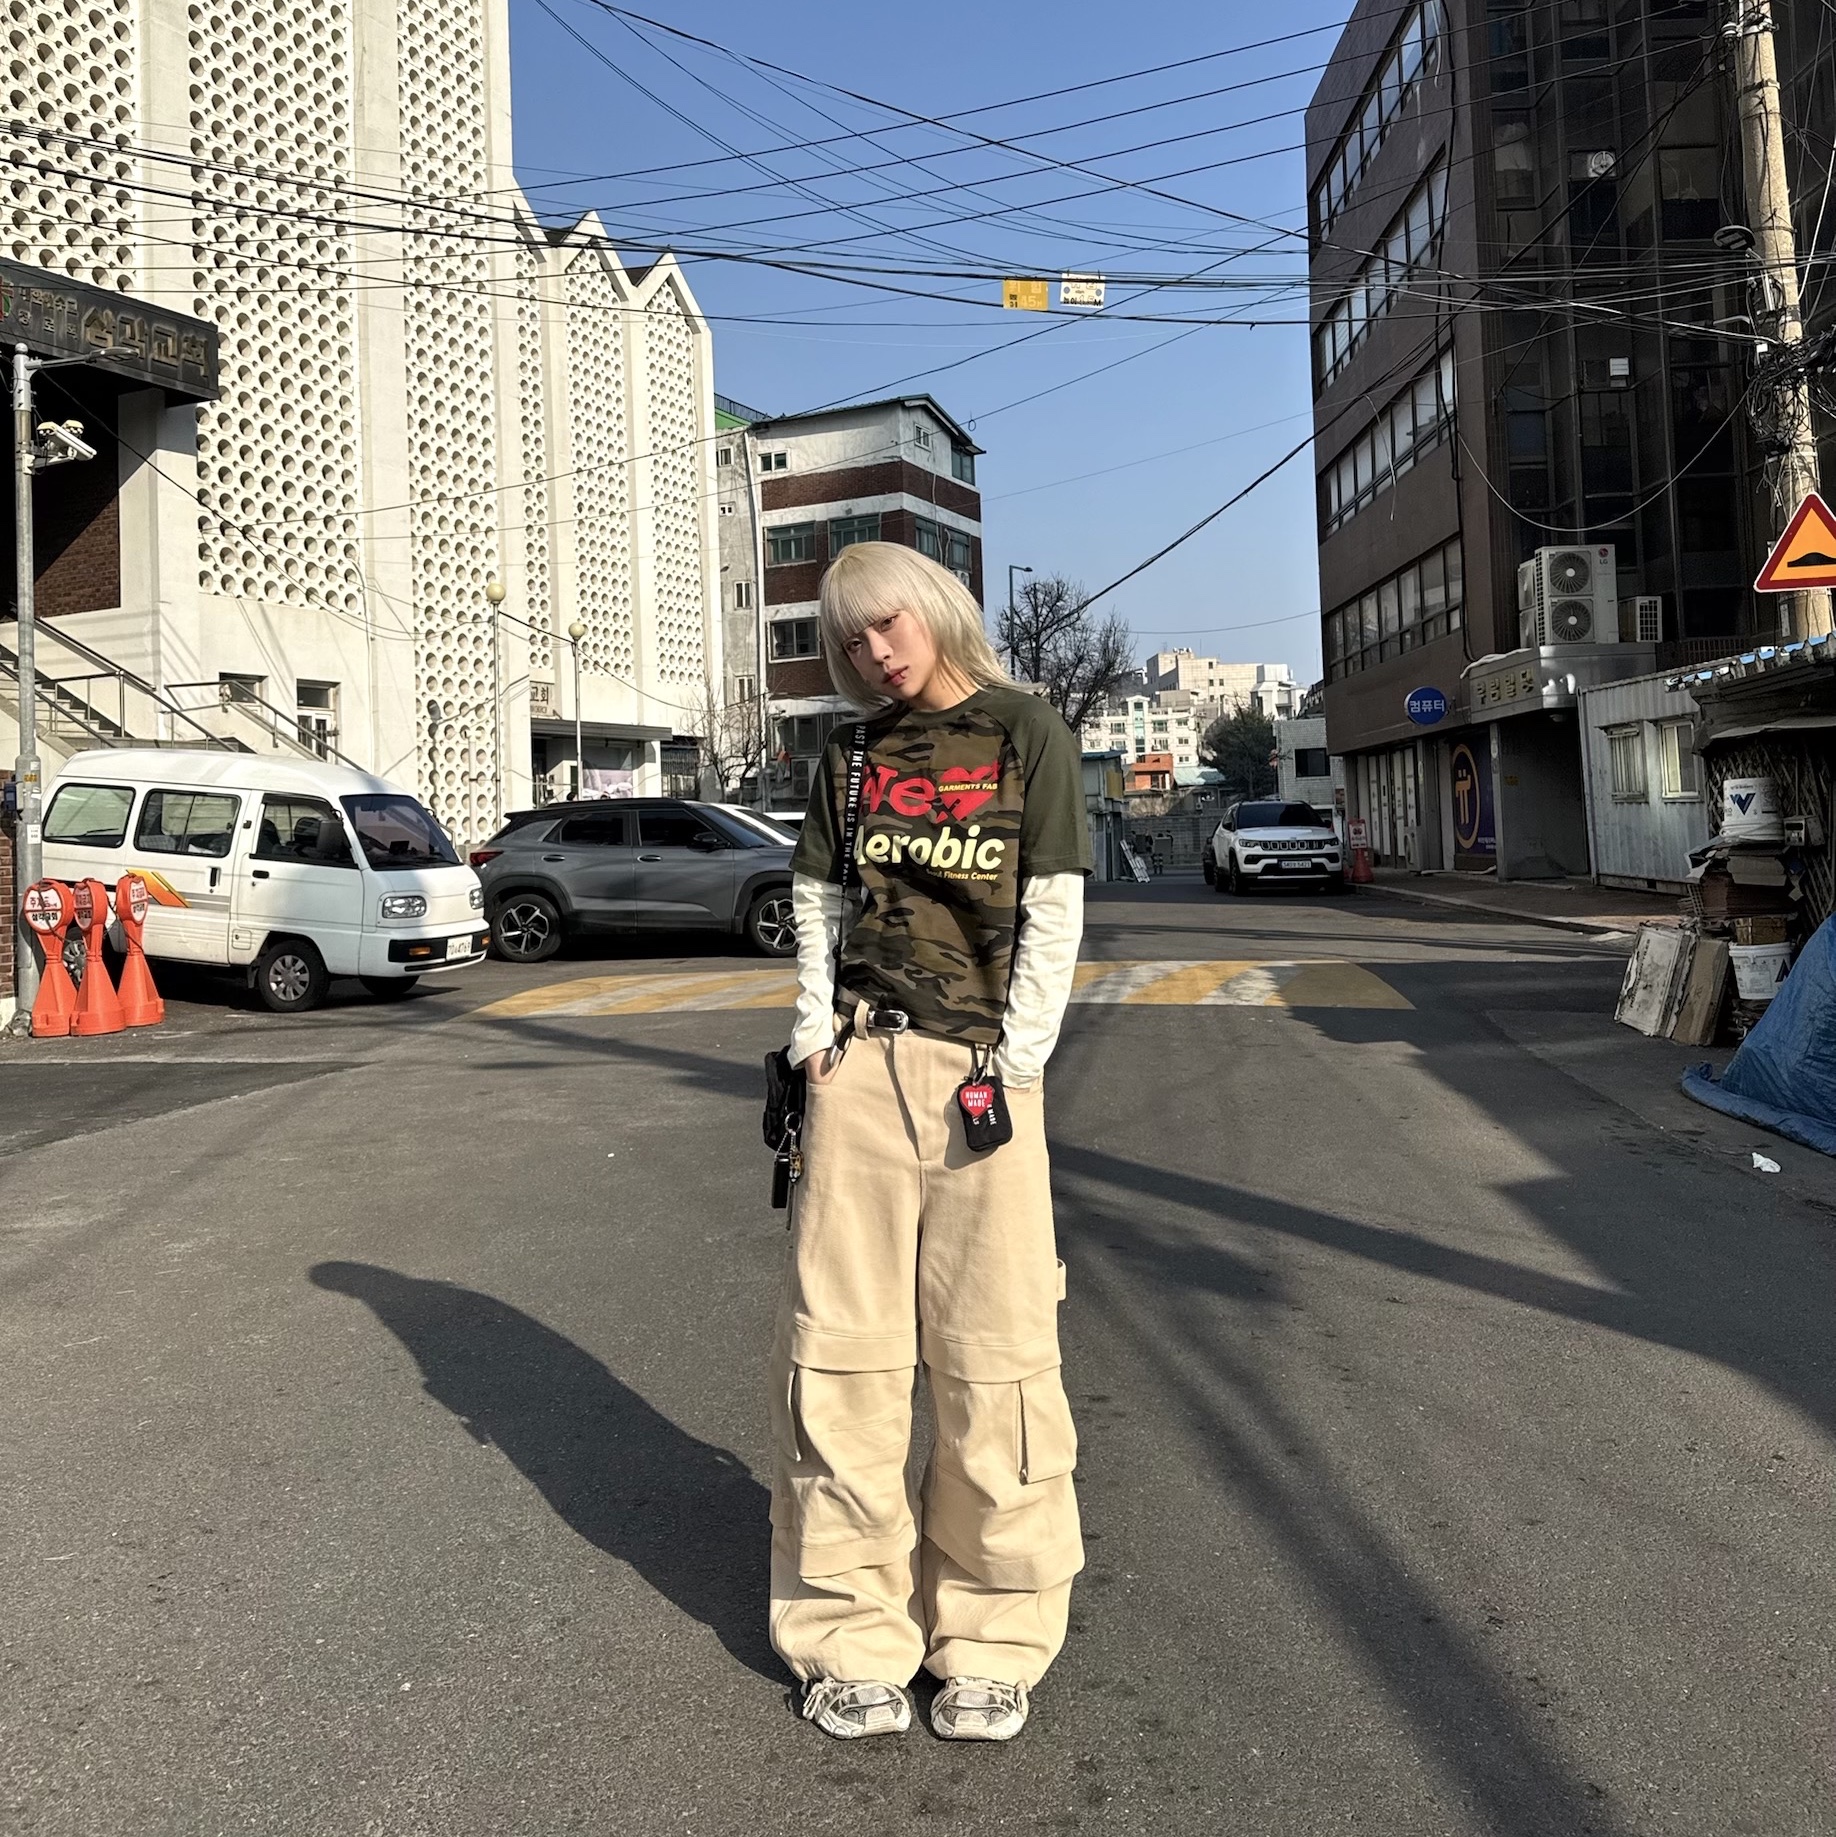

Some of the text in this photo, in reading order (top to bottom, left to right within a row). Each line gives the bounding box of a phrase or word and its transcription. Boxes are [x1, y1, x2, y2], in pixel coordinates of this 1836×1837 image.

[1409, 699, 1445, 713] 컴퓨터
[852, 750, 864, 768] THE
[848, 771, 861, 808] FUTURE
[938, 783, 980, 793] GARMENTS
[846, 813, 856, 823] IS
[845, 827, 854, 838] IN
[844, 841, 853, 858] THE
[944, 870, 969, 880] Fitness
[971, 871, 998, 881] Center
[965, 1091, 988, 1099] HUMAN
[967, 1099, 985, 1107] MADE
